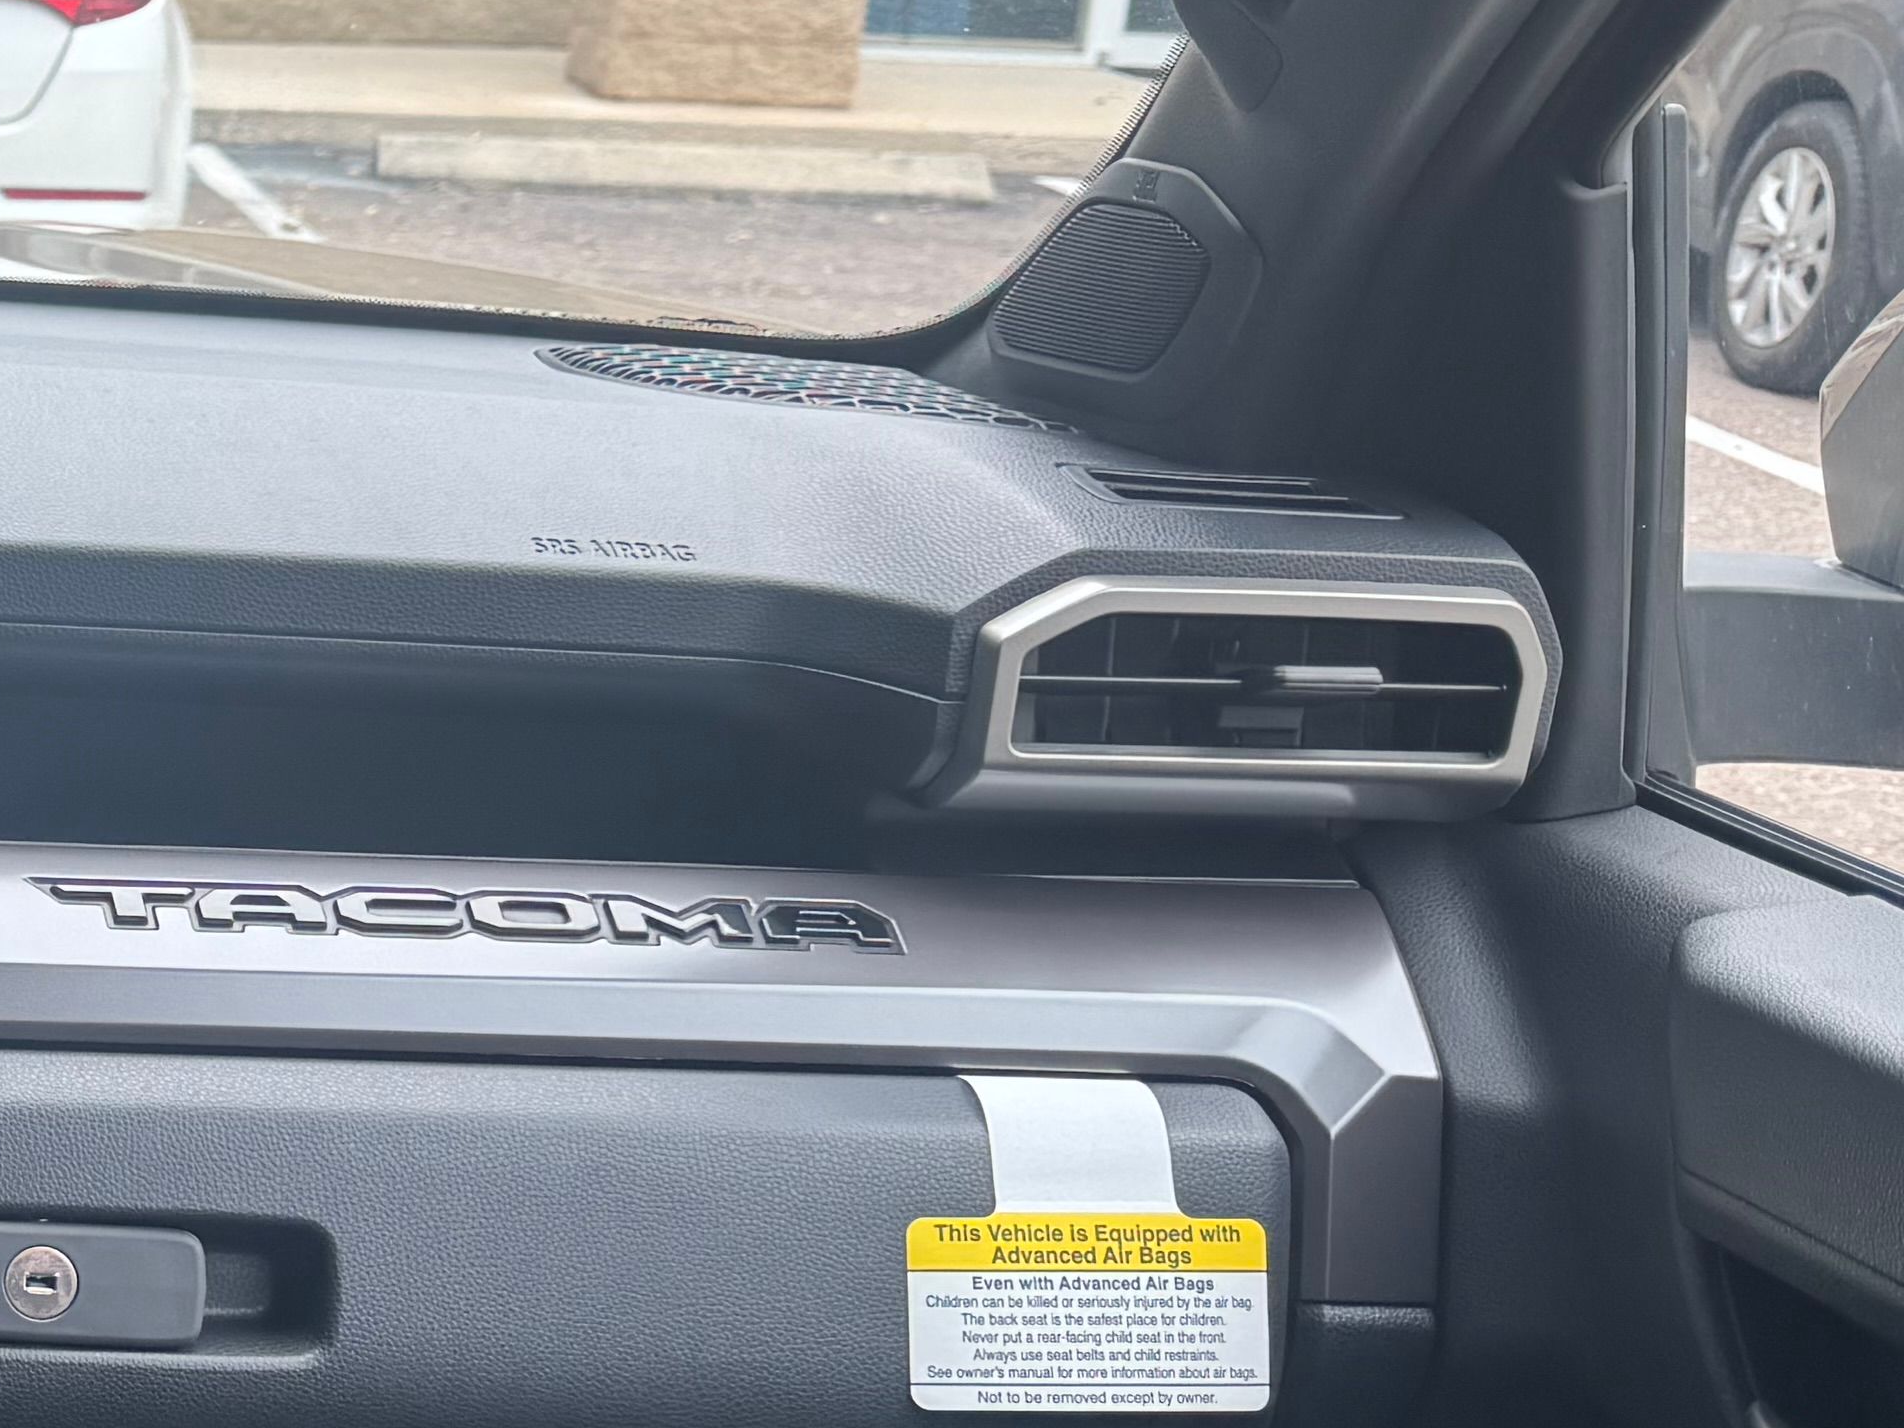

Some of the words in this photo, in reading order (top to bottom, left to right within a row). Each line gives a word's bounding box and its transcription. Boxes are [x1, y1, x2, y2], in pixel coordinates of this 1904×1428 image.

[531, 537, 582, 556] SRS
[589, 539, 697, 562] AIRBAG
[23, 876, 908, 956] TACOMA
[933, 1224, 981, 1242] This
[987, 1224, 1063, 1242] Vehicle
[1070, 1224, 1088, 1242] is
[1094, 1225, 1193, 1247] Equipped
[1200, 1225, 1241, 1242] with
[992, 1246, 1096, 1264] Advanced
[1103, 1246, 1132, 1264] Air
[1139, 1247, 1192, 1268] Bags
[972, 1276, 1014, 1290] Even
[1019, 1276, 1054, 1290] with
[1059, 1276, 1141, 1290] Advanced
[1145, 1276, 1169, 1290] Air
[1174, 1277, 1215, 1293] Bags
[925, 1295, 978, 1308] Children
[982, 1298, 1004, 1308] can
[1008, 1296, 1023, 1308] be
[1027, 1295, 1058, 1308] killed
[1062, 1299, 1074, 1308] or
[1078, 1296, 1130, 1311] seriously
[1133, 1296, 1174, 1311] injured
[1177, 1296, 1190, 1311] by
[1194, 1296, 1211, 1308] the
[1215, 1296, 1228, 1308] air
[961, 1313, 985, 1326] The
[989, 1313, 1018, 1326] back
[1021, 1314, 1048, 1326] seat
[1051, 1313, 1061, 1326] is
[1065, 1313, 1083, 1326] the
[1087, 1313, 1123, 1326] safest
[1126, 1313, 1157, 1328] place
[1161, 1313, 1176, 1326] for
[1179, 1314, 1226, 1326] children.
[962, 1331, 998, 1343] Never
[1003, 1332, 1022, 1346] put
[1026, 1334, 1034, 1343] a
[1037, 1331, 1101, 1346] rear-facing
[1105, 1331, 1132, 1344] child
[1136, 1332, 1161, 1344] seat
[1164, 1331, 1174, 1344] in
[1178, 1331, 1195, 1344] the
[1199, 1331, 1226, 1344] front.
[973, 1349, 1017, 1364] Always
[1021, 1351, 1043, 1361] use
[1047, 1350, 1073, 1361] seat
[1076, 1349, 1105, 1361] belts
[1109, 1349, 1130, 1361] and
[1134, 1349, 1161, 1361] child
[1164, 1350, 1219, 1362] restraints.
[927, 1366, 952, 1378] See
[956, 1367, 1004, 1378] owner's
[1008, 1366, 1054, 1378] manual
[1058, 1366, 1073, 1378] for
[1077, 1369, 1107, 1378] more
[1110, 1366, 1175, 1379] information
[1178, 1366, 1210, 1379] about
[1213, 1367, 1227, 1379] air
[1230, 1366, 1258, 1381] bags.
[977, 1391, 1002, 1403] Not
[1007, 1393, 1020, 1403] to
[1025, 1391, 1042, 1403] be
[1047, 1391, 1106, 1404] removed
[1111, 1392, 1154, 1406] except
[1158, 1391, 1173, 1406] by
[1176, 1393, 1218, 1404] owner.
